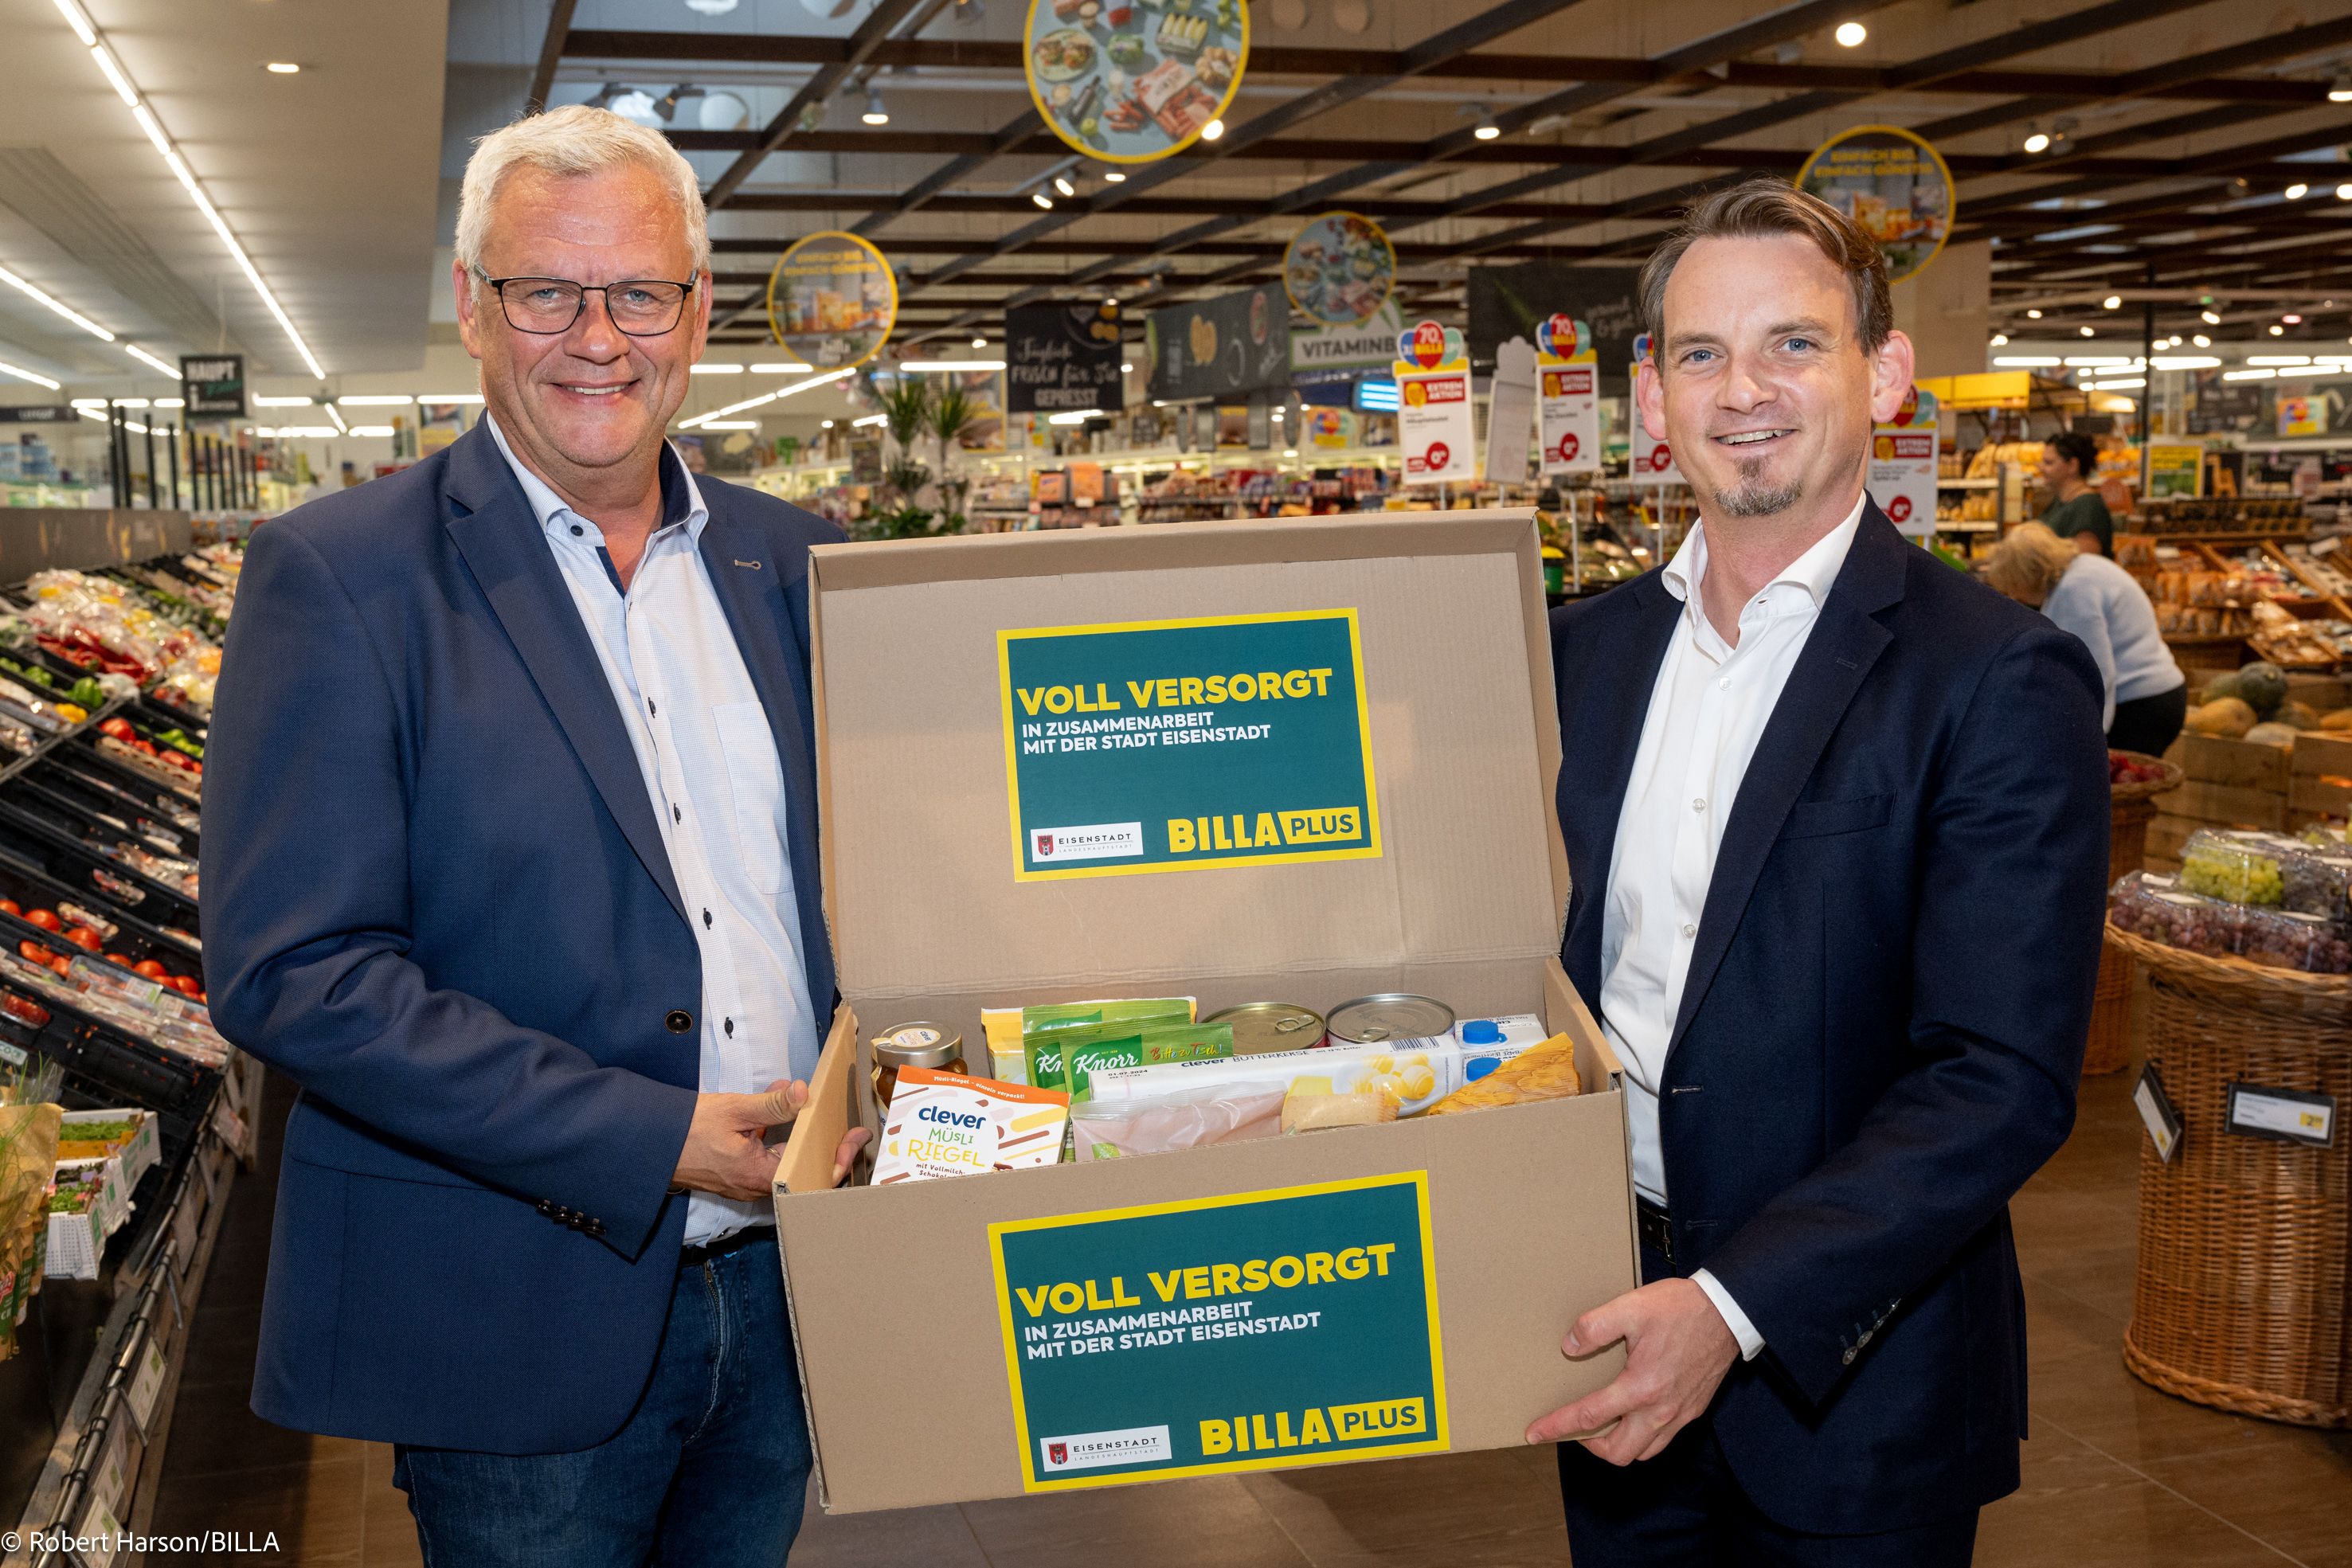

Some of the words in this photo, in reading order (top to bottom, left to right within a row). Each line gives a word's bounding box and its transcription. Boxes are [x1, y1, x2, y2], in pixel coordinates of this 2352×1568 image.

[1301, 336, 1399, 358] VITAMINB
[1016, 683, 1121, 716] VOLL
[1127, 668, 1333, 708] VERSORGT
[1023, 723, 1042, 737] IN
[1046, 712, 1215, 737] ZUSAMMENARBEIT
[1023, 740, 1055, 754] MIT
[1061, 736, 1098, 753] DER
[1102, 732, 1157, 749] STADT
[1163, 725, 1271, 745] EISENSTADT
[1059, 833, 1132, 844] EISENSTADT
[1168, 812, 1281, 853] BILLA
[1290, 814, 1355, 838] PLUS
[1073, 1052, 1139, 1074] Knorr
[1149, 1047, 1176, 1061] Bitte
[1181, 1058, 1226, 1068] clever
[1233, 1050, 1309, 1062] BUTTERKEKSE
[976, 1083, 996, 1093] einzeln
[997, 1090, 1025, 1100] verpackt!
[918, 1106, 987, 1129] clever
[929, 1128, 974, 1145] MÜSLI
[907, 1140, 985, 1167] RIEGEL
[930, 1164, 965, 1175] Vollmilch-
[1015, 1277, 1141, 1317] VOLL
[1148, 1243, 1395, 1302] VERSORGT
[1024, 1324, 1048, 1342] IN
[1053, 1301, 1253, 1339] ZUSAMMENARBEIT
[1027, 1342, 1066, 1360] MIT
[1071, 1337, 1114, 1356] DER
[1120, 1328, 1186, 1351] STADT
[1192, 1312, 1321, 1341] EISENSTADT
[1199, 1409, 1332, 1456] BILLA
[1342, 1405, 1418, 1433] PLUS
[1074, 1437, 1157, 1453] EISENSTADT
[1074, 1449, 1159, 1461] LANDESHAUPTSTADT
